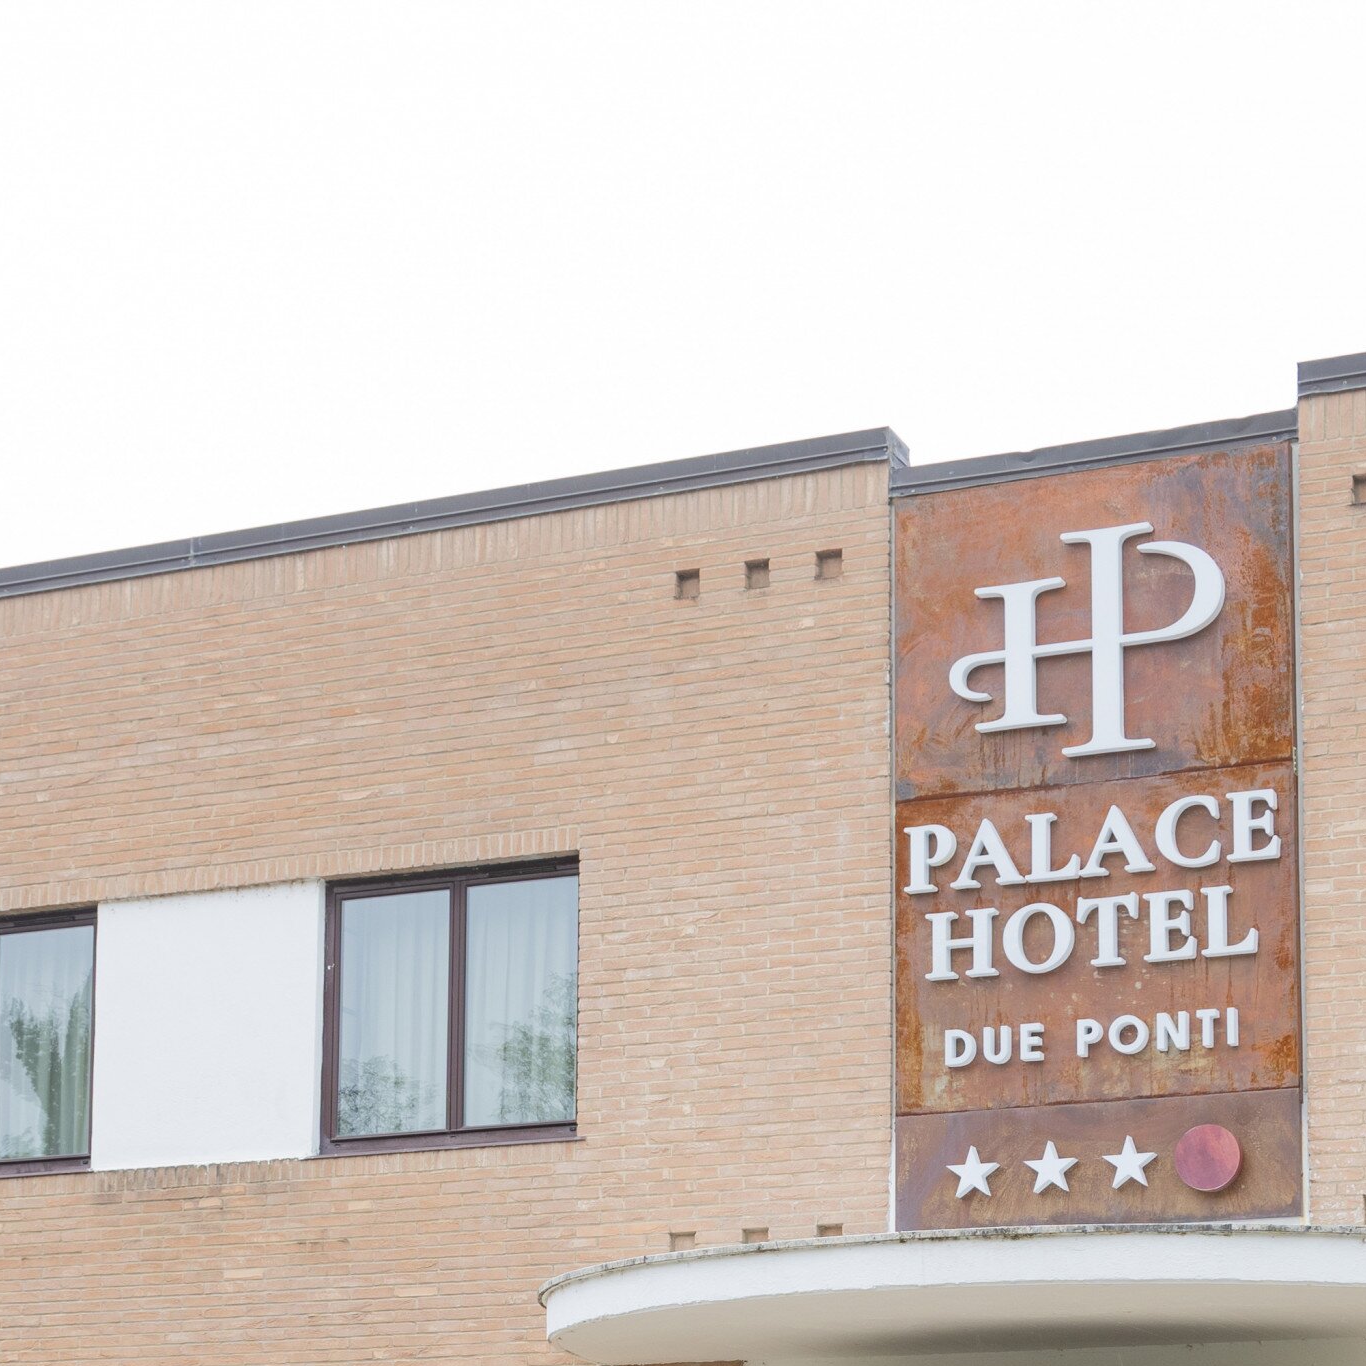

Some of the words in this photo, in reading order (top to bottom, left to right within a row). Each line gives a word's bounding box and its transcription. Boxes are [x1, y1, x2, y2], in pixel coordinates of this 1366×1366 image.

[903, 788, 1282, 896] PALACE
[925, 885, 1259, 982] HOTEL
[944, 1022, 1045, 1068] DUE
[1076, 1007, 1240, 1058] PONTI
